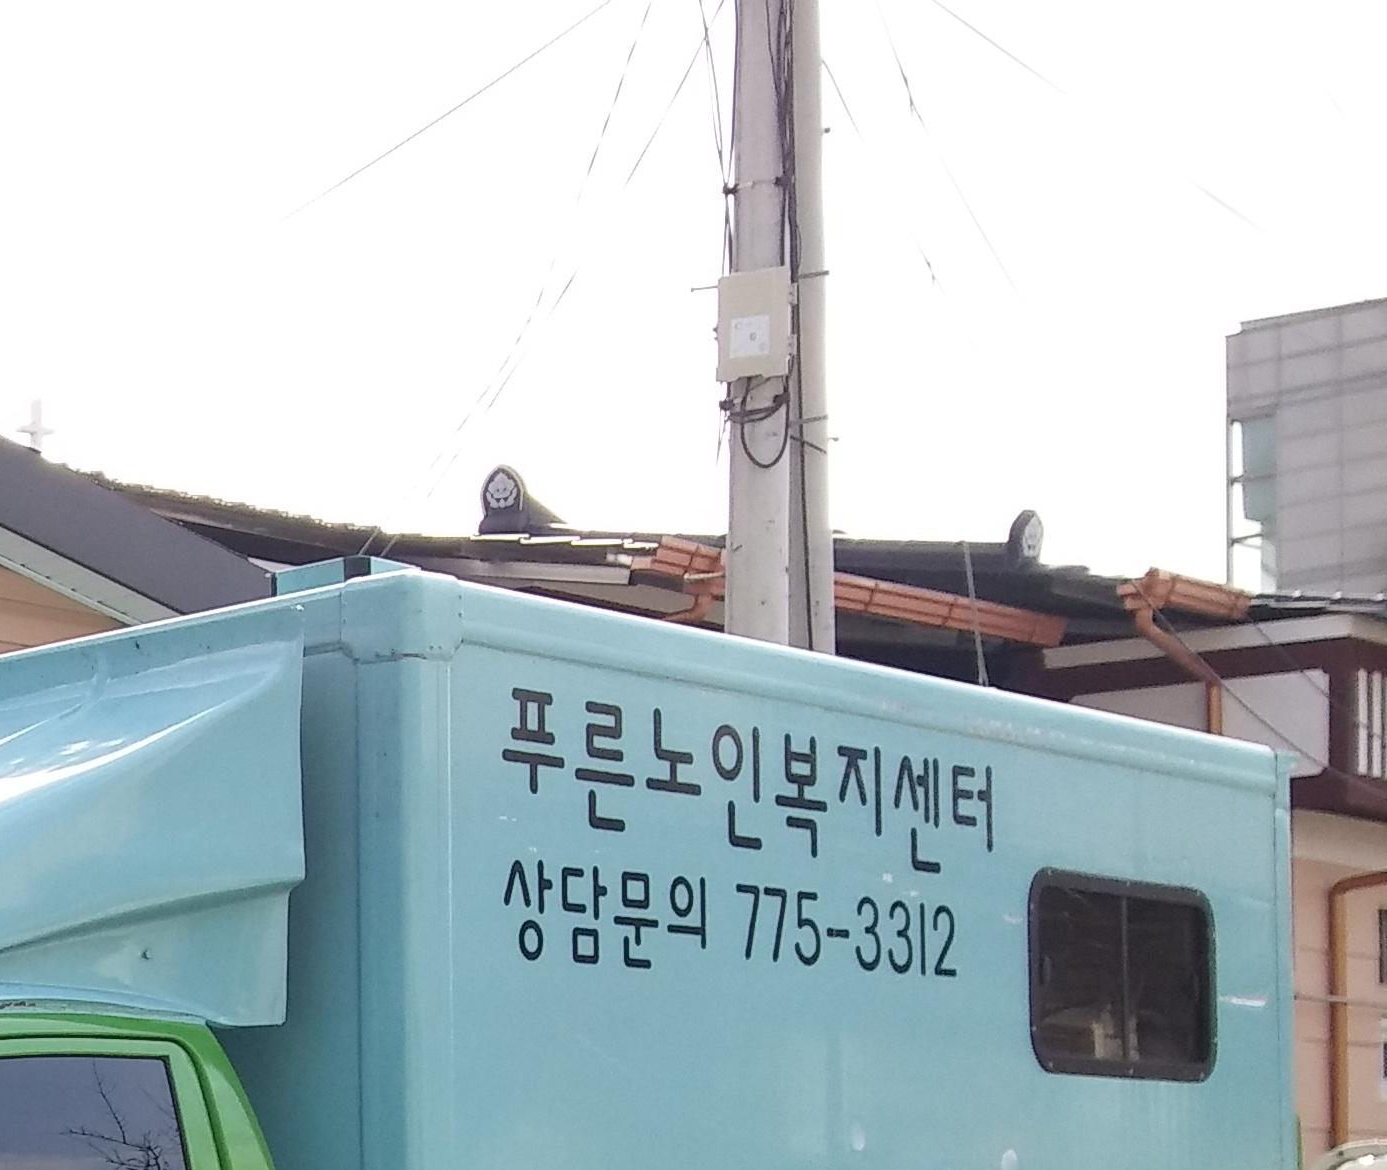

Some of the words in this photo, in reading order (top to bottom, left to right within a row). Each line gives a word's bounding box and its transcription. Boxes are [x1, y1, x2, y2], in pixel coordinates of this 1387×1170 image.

[502, 687, 994, 874] 푸른노인복지센터
[503, 858, 707, 969] 상담문의
[736, 883, 957, 977] 775-3312
